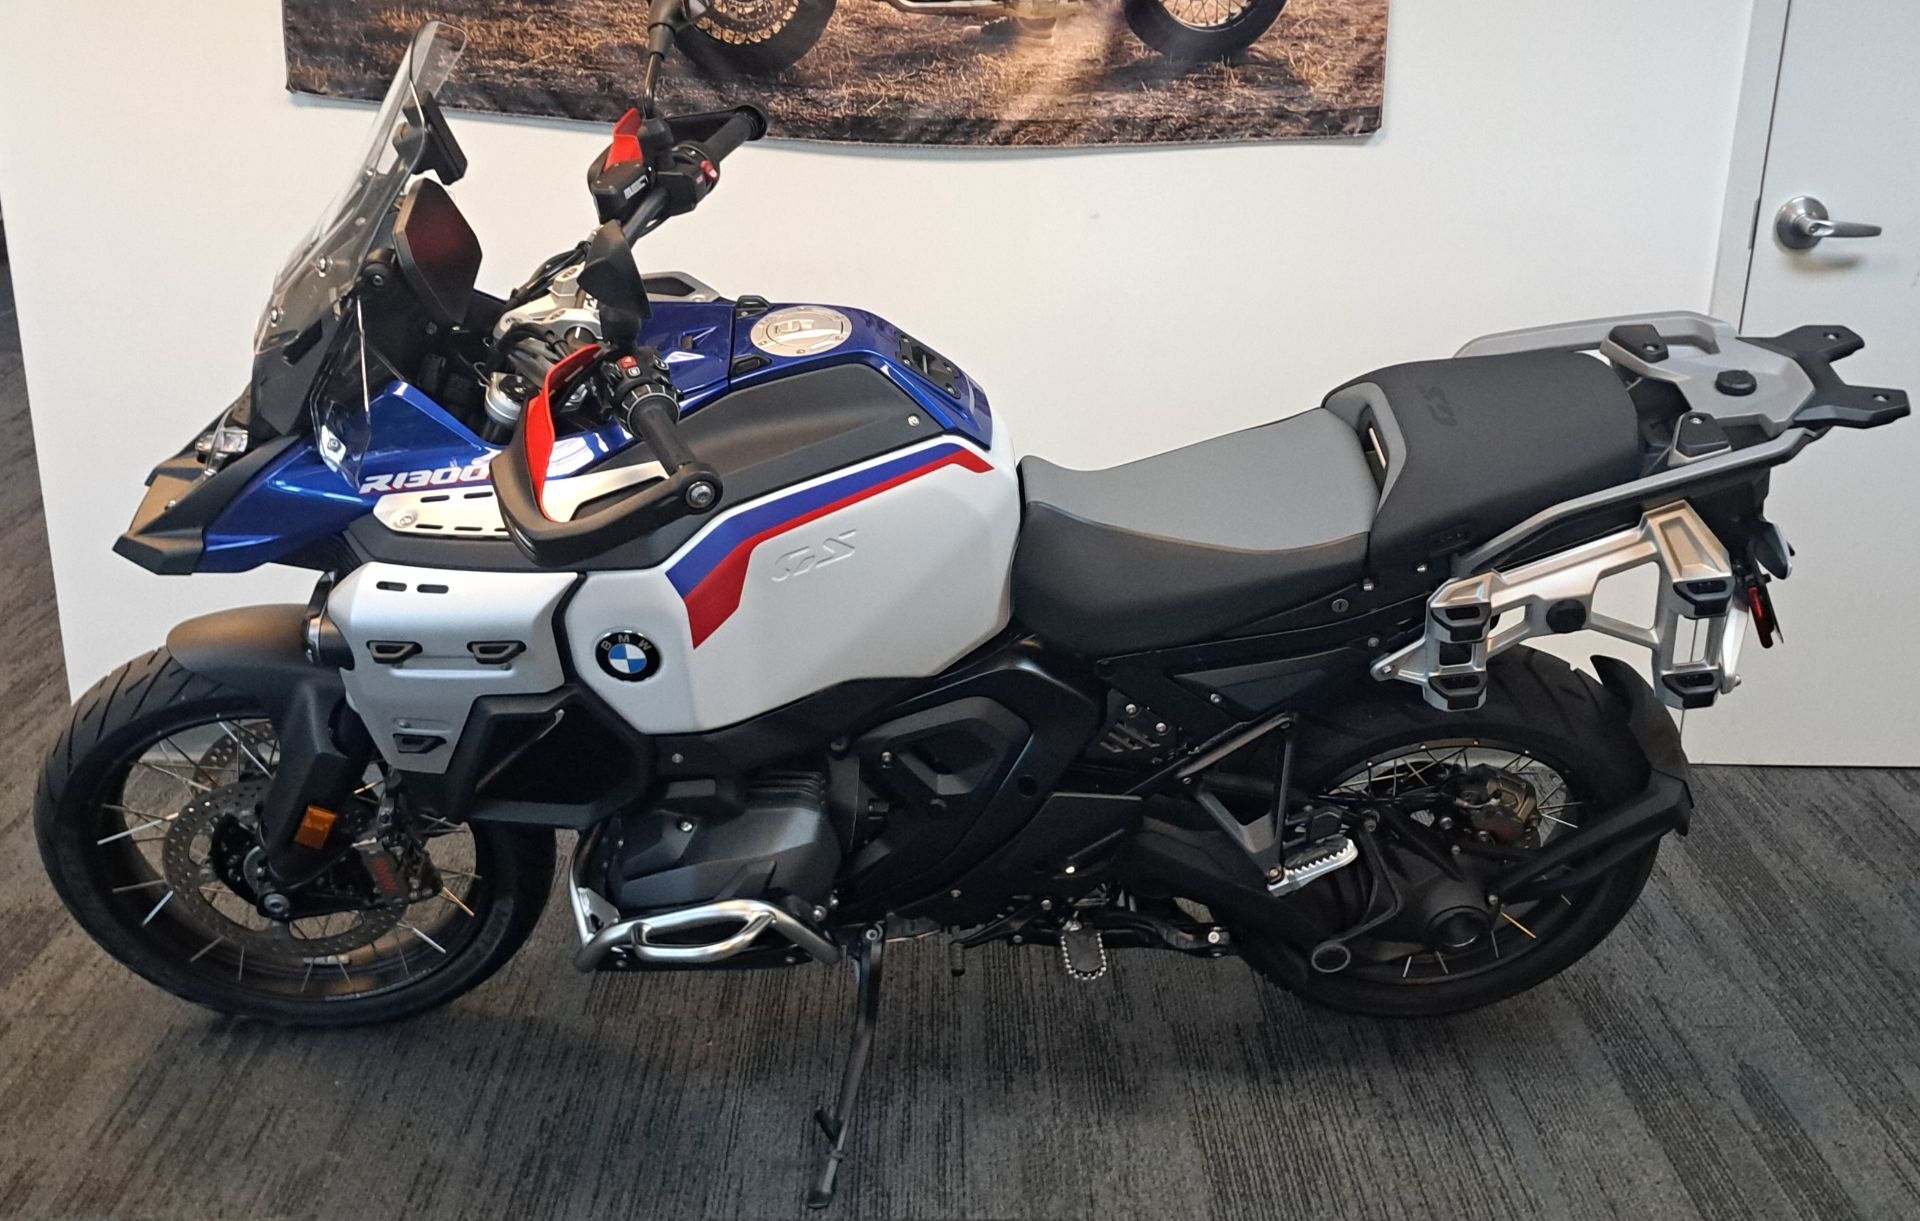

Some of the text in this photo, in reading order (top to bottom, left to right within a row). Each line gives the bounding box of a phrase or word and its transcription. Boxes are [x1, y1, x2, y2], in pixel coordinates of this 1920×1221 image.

[359, 463, 491, 494] R1300
[771, 528, 857, 582] GS
[600, 633, 653, 652] BMW
